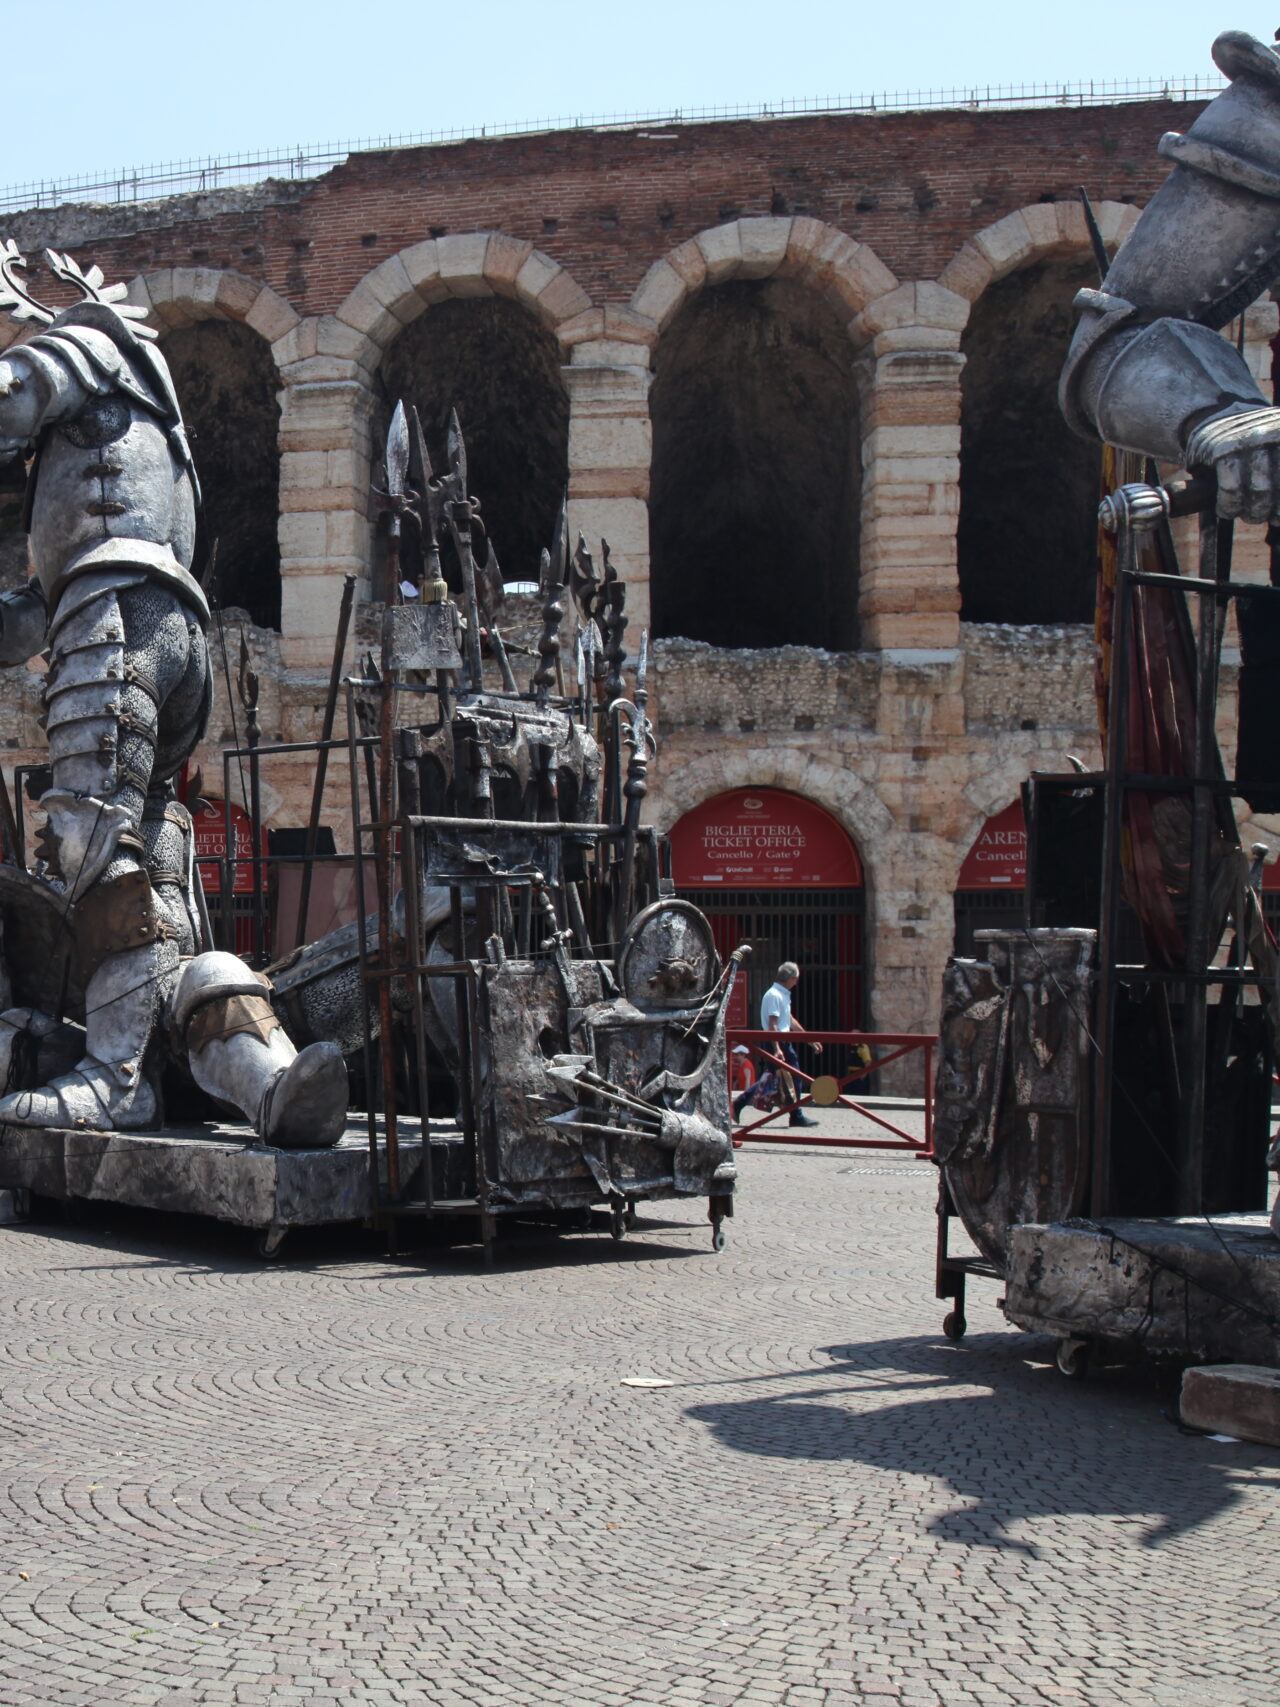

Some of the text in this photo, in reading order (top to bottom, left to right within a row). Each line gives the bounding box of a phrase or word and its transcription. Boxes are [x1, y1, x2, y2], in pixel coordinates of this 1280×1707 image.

[705, 825, 802, 836] BIGLIETTERIA
[701, 837, 806, 848] TICKET OFFICE
[980, 832, 1026, 845] AREN
[707, 850, 753, 860] Cancello
[765, 850, 791, 860] Gate
[792, 849, 801, 860] 9
